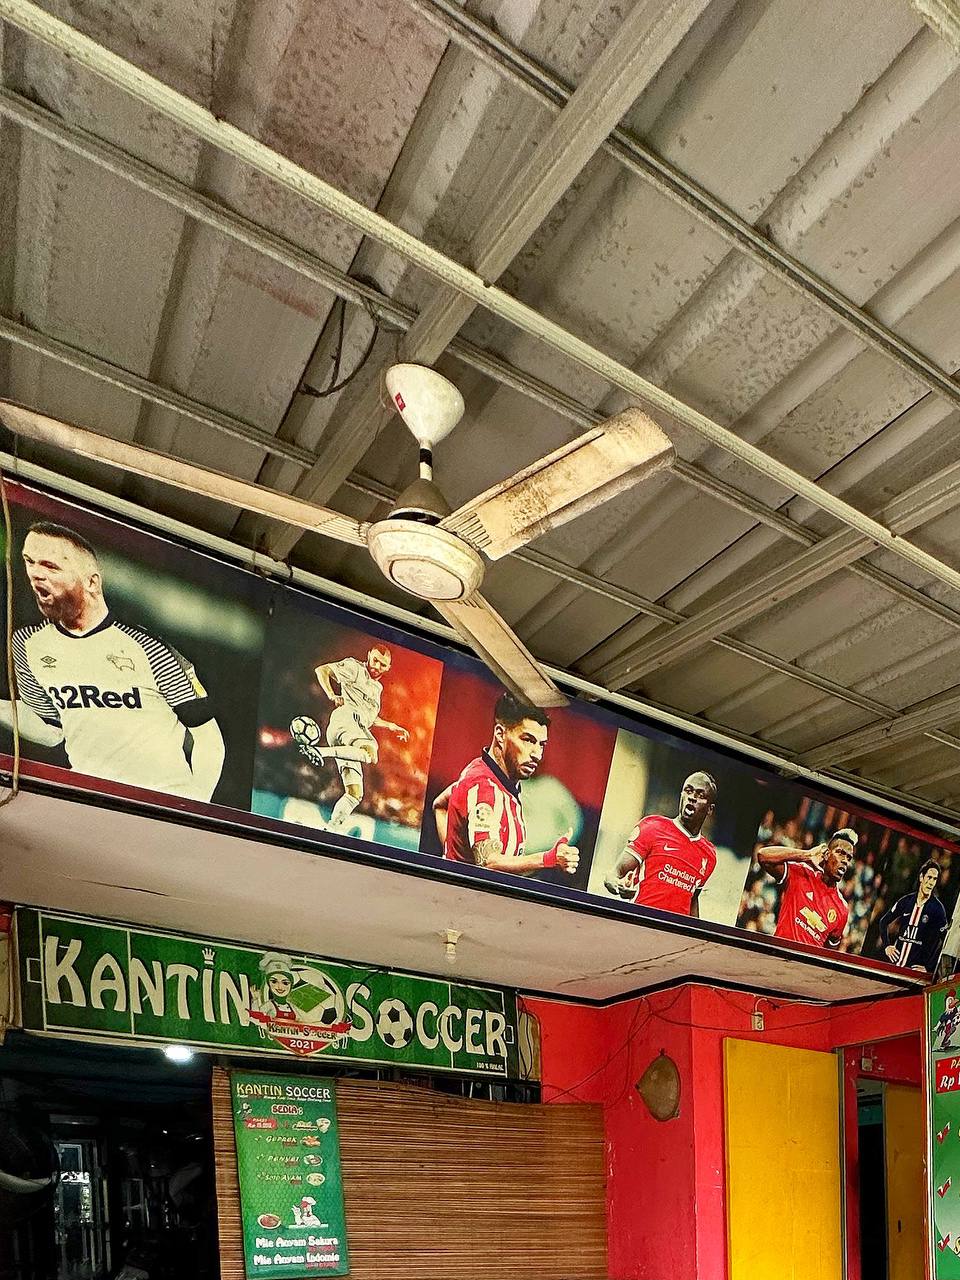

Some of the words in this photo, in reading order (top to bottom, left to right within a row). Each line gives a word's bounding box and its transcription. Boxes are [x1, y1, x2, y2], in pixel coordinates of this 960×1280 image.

[50, 685, 143, 710] 32Red
[658, 871, 692, 892] Chartered
[664, 863, 696, 884] Standard
[45, 935, 251, 1028] KANTIN
[290, 1040, 314, 1049] 2021
[236, 1083, 282, 1096] KANTIN
[285, 1086, 331, 1099] SOCCER
[939, 1073, 956, 1089] Rp
